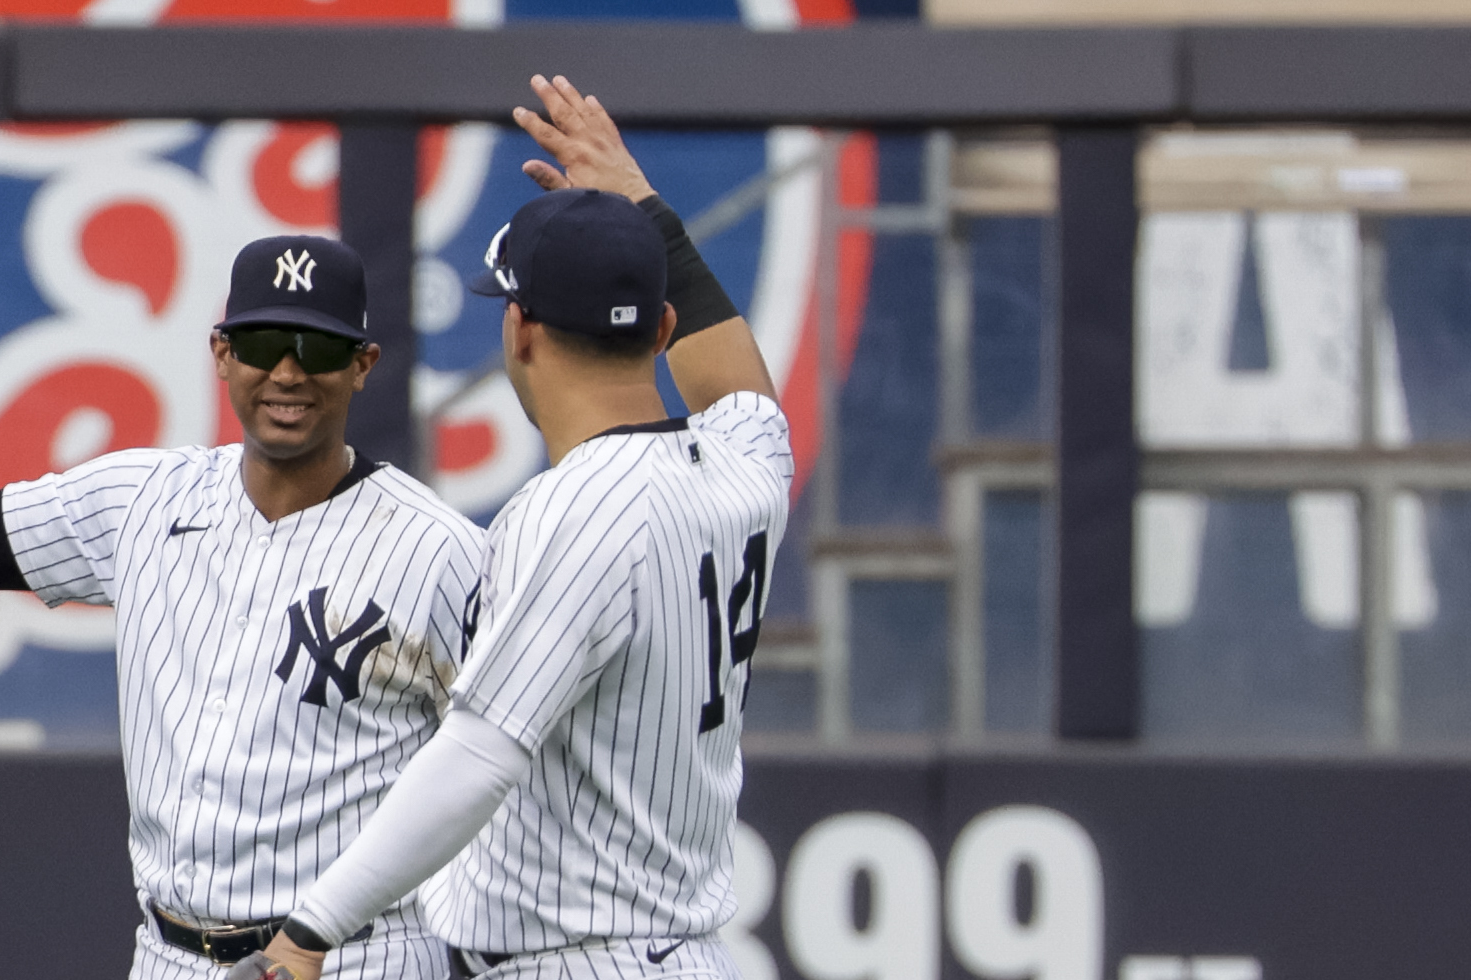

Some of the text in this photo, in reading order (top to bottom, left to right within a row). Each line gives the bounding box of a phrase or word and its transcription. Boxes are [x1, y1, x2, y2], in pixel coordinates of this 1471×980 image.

[272, 248, 318, 293] NY
[274, 585, 392, 708] NY
[698, 530, 768, 734] 14
